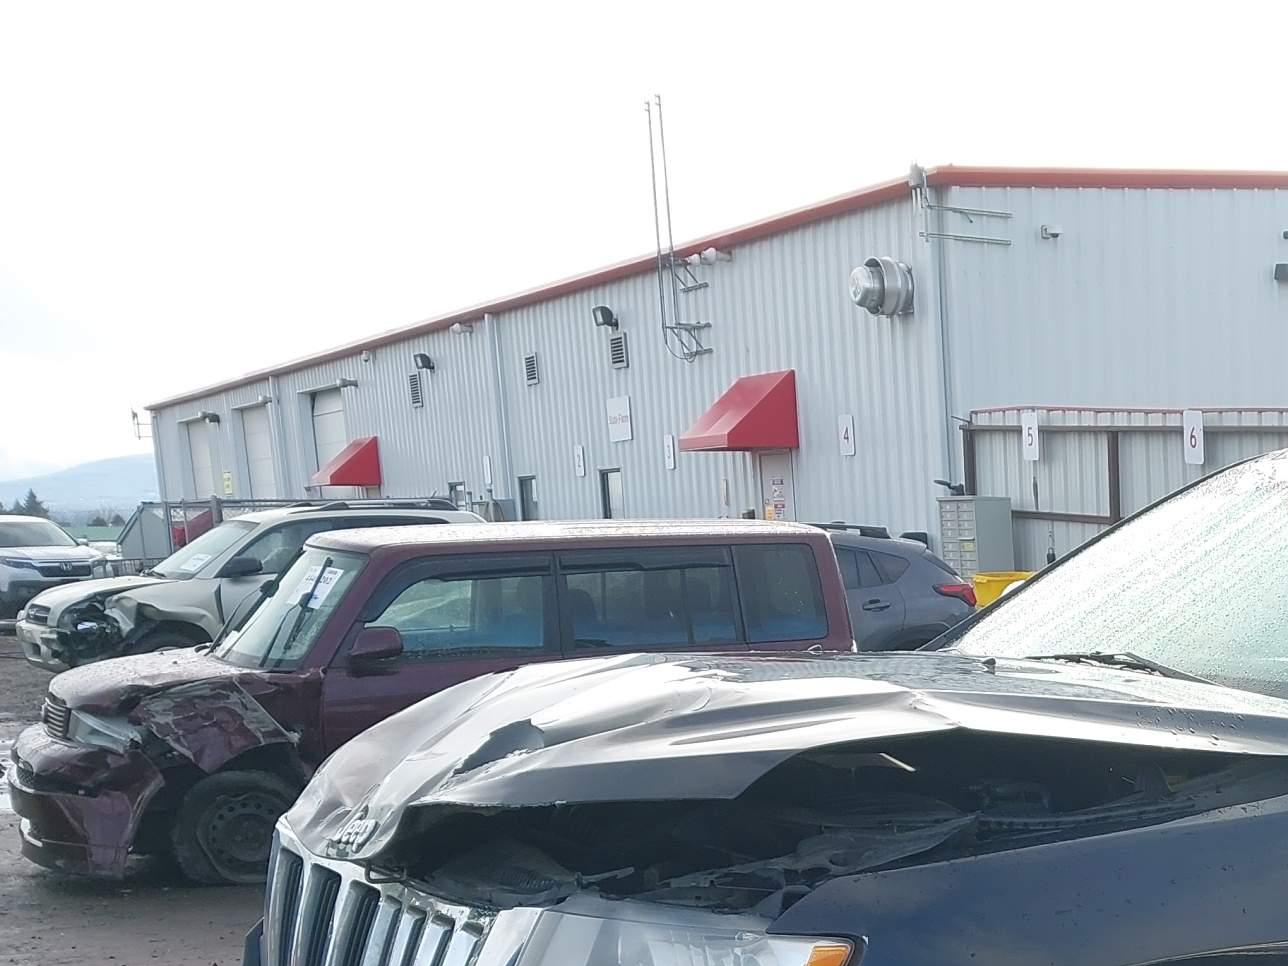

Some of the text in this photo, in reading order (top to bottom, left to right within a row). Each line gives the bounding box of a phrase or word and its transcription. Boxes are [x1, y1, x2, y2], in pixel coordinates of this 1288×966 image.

[843, 426, 850, 445] 4
[1027, 426, 1034, 447] 5
[1189, 426, 1197, 449] 6
[335, 812, 377, 854] Jeep
